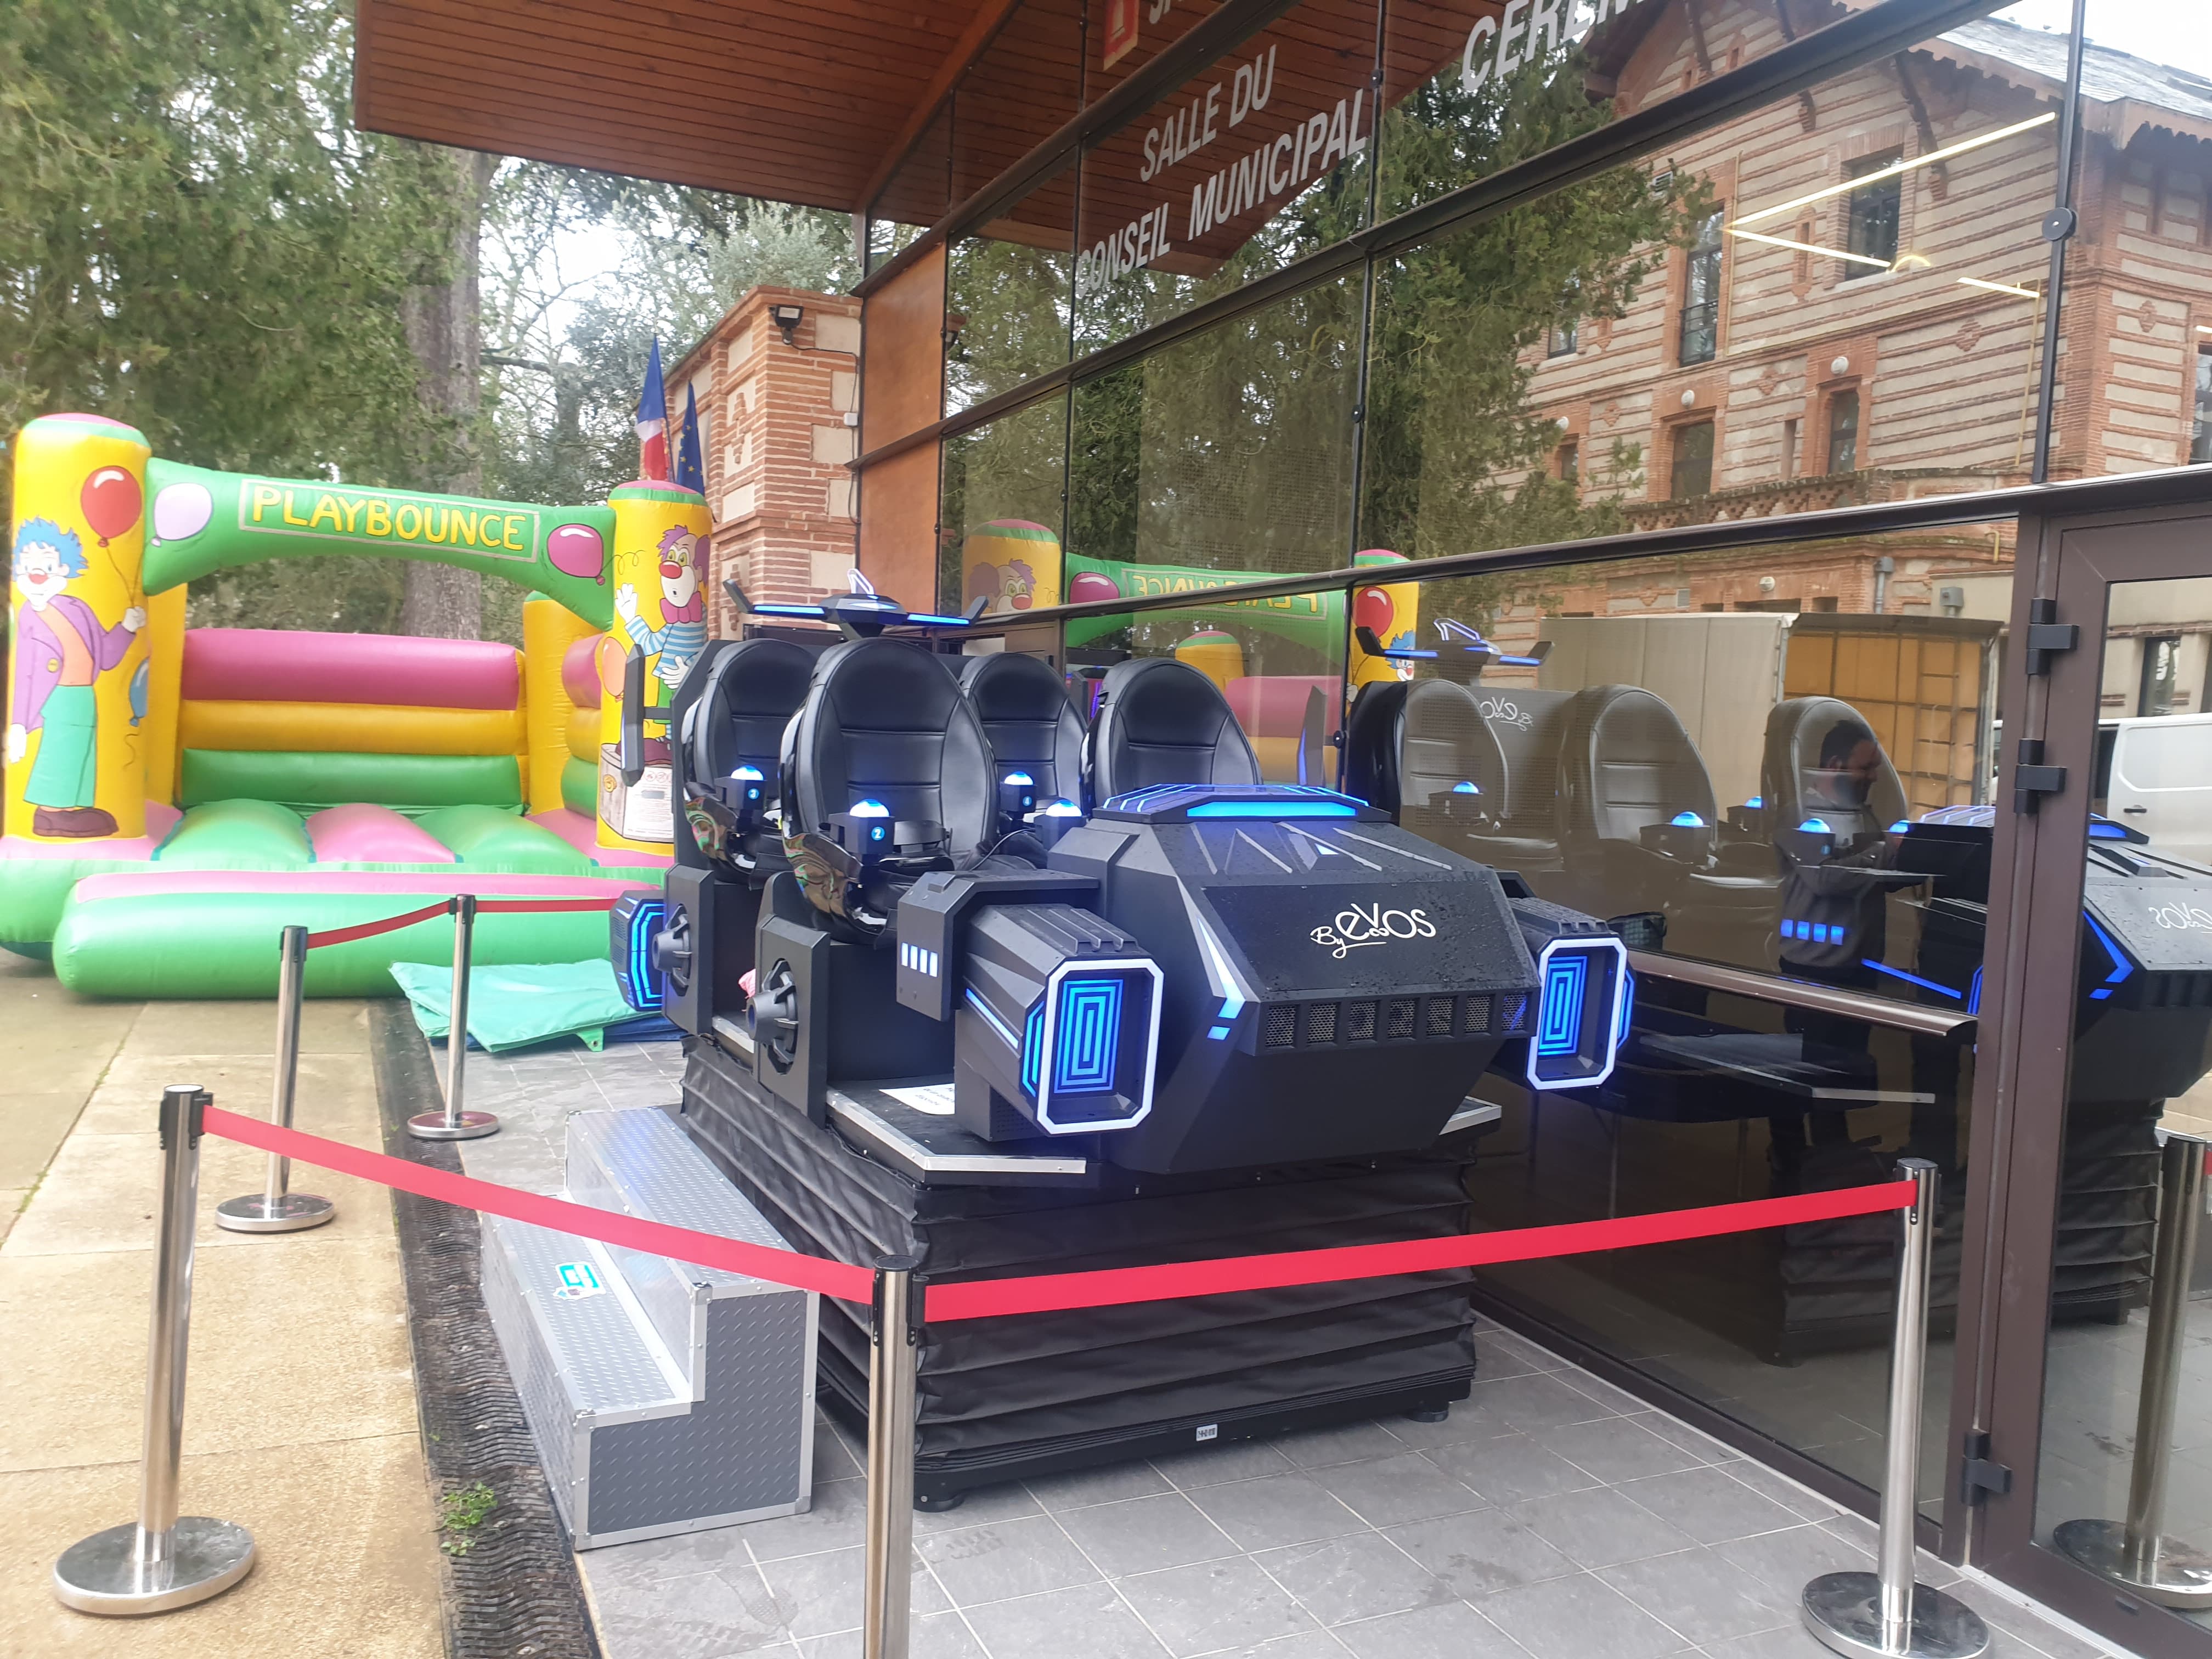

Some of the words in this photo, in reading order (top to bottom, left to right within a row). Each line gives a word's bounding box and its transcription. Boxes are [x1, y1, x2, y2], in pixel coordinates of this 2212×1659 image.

[1462, 0, 1646, 91] CERE
[1140, 82, 1222, 182] SALLE
[1229, 43, 1277, 128] DU
[1075, 202, 1171, 298] CONSEIL
[1187, 88, 1366, 242] MUNICIPAL
[252, 485, 527, 551] PLAYBOUNCE
